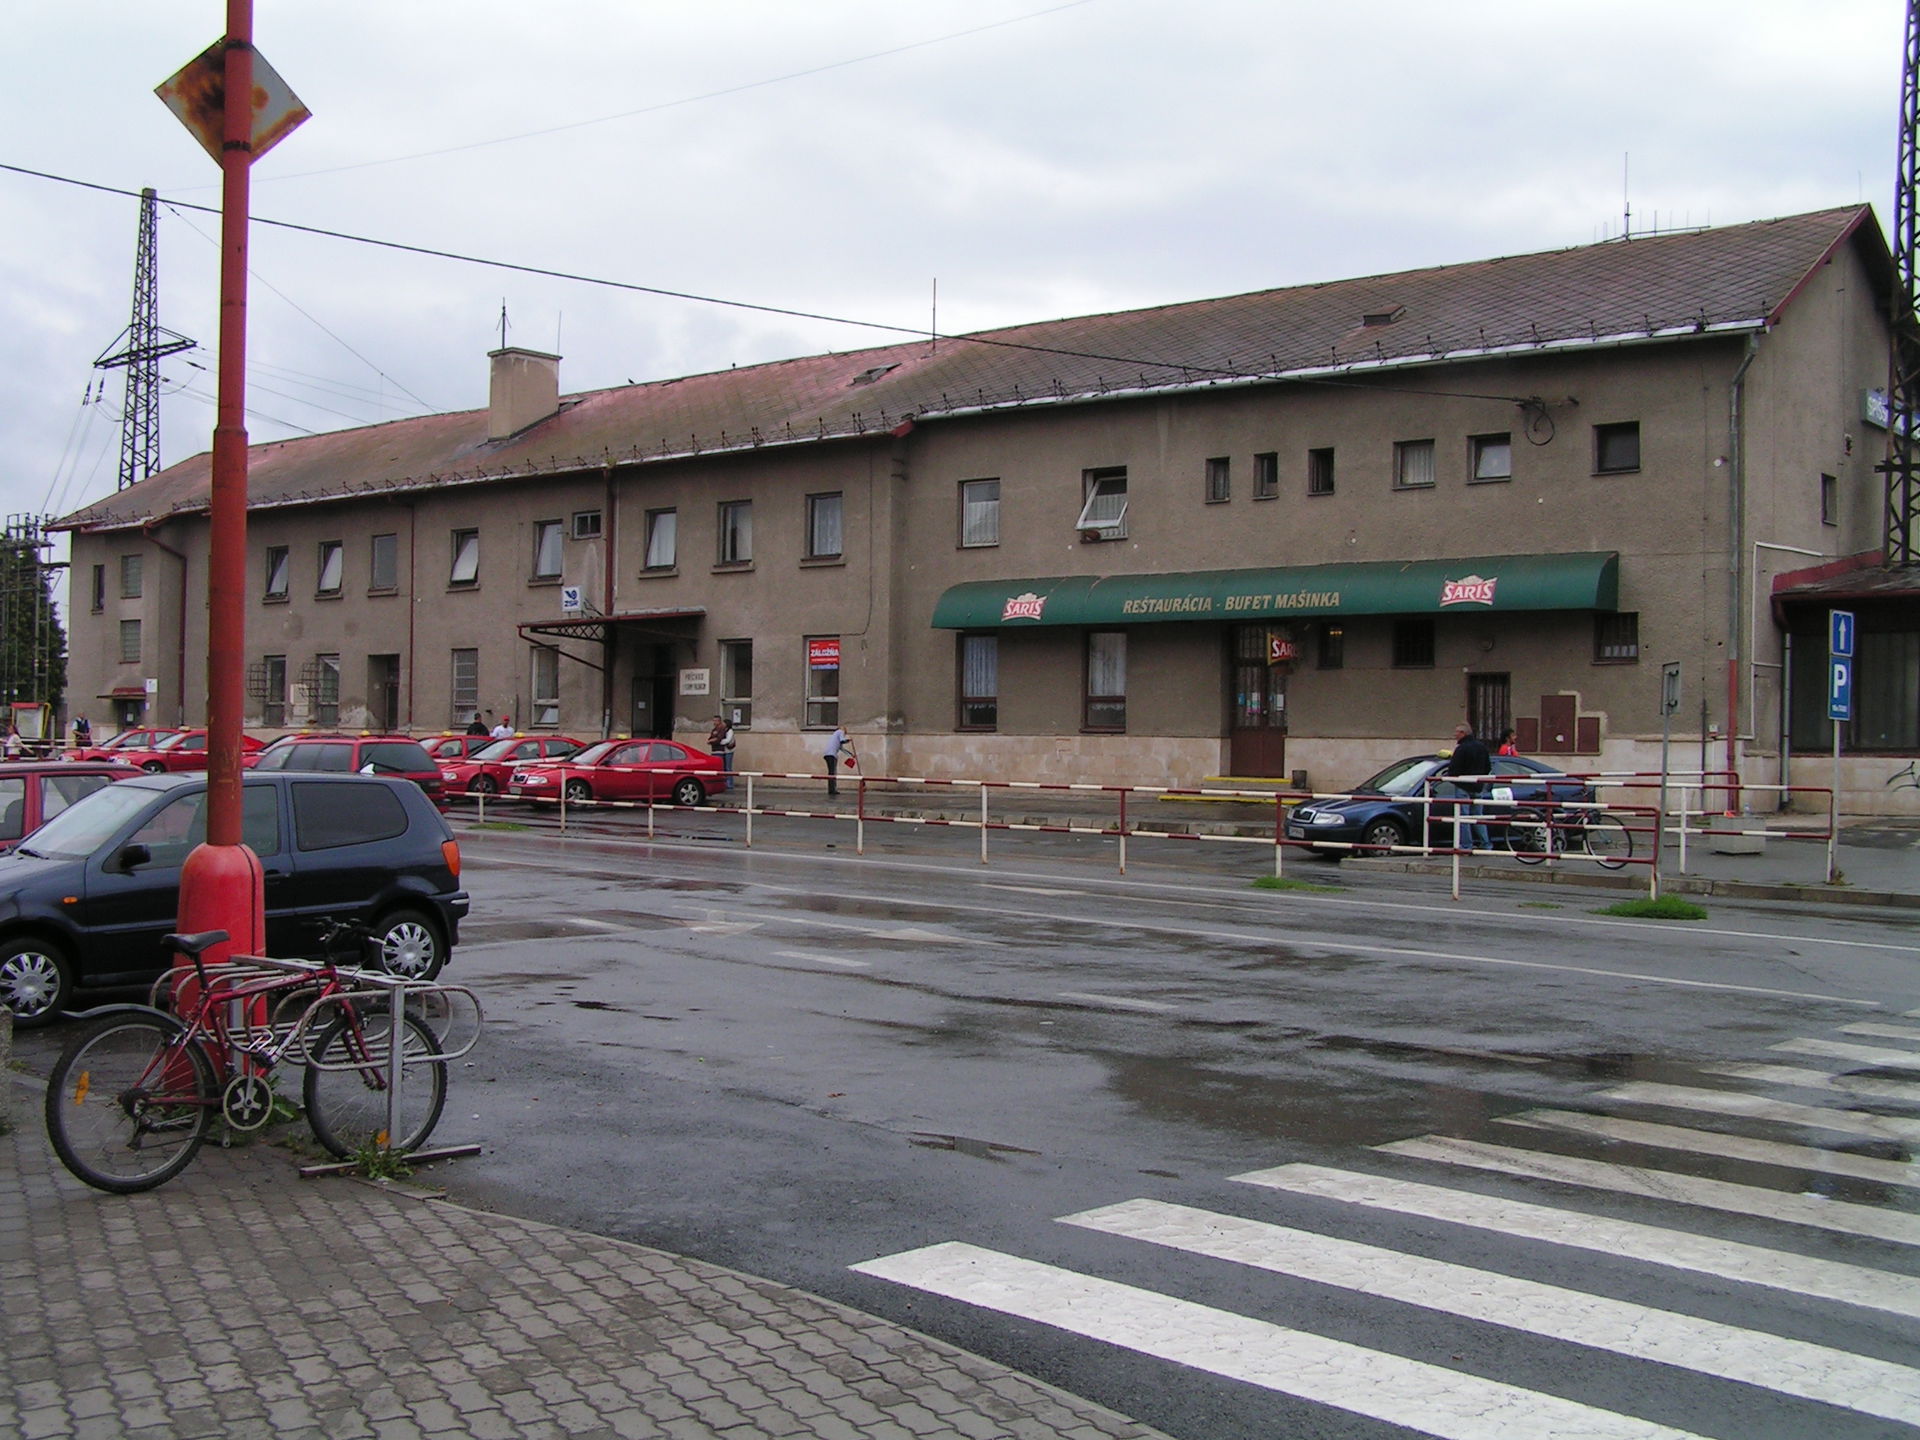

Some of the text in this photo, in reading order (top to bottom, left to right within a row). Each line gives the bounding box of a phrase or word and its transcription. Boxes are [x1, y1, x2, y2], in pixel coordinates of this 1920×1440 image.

[1224, 594, 1273, 611] BUFET
[1274, 589, 1340, 609] MAŠINKA
[1833, 663, 1847, 699] P
